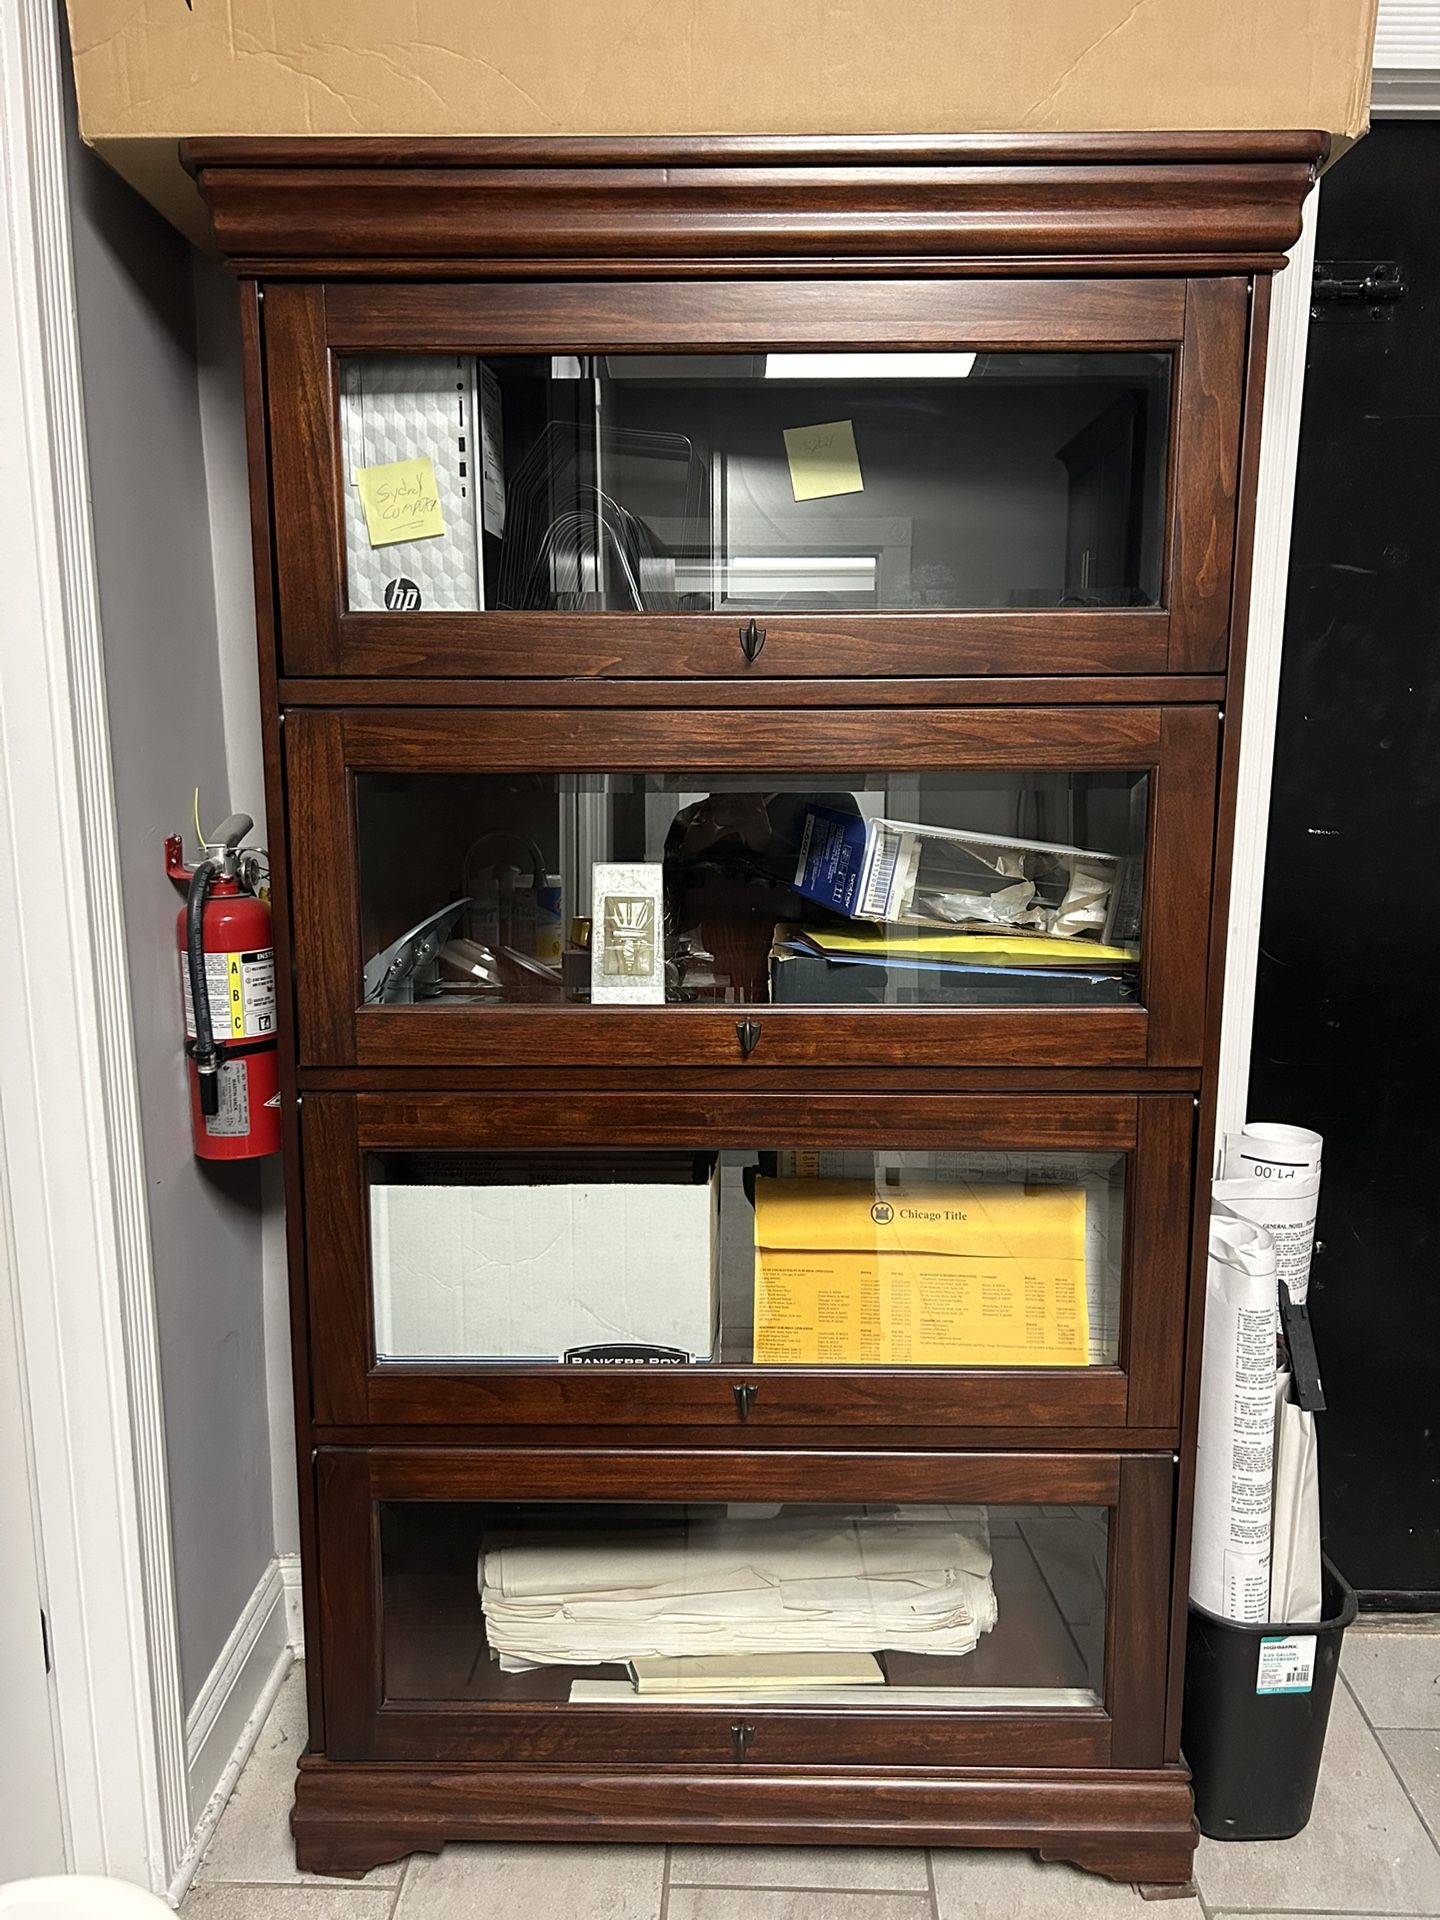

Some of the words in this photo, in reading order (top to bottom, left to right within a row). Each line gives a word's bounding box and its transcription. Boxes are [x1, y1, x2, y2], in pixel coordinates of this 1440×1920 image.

[845, 873, 857, 909] brother
[231, 962, 238, 974] A
[233, 989, 240, 1002] B
[234, 1016, 242, 1029] C
[899, 1209, 941, 1222] Chicago
[943, 1210, 968, 1221] Title
